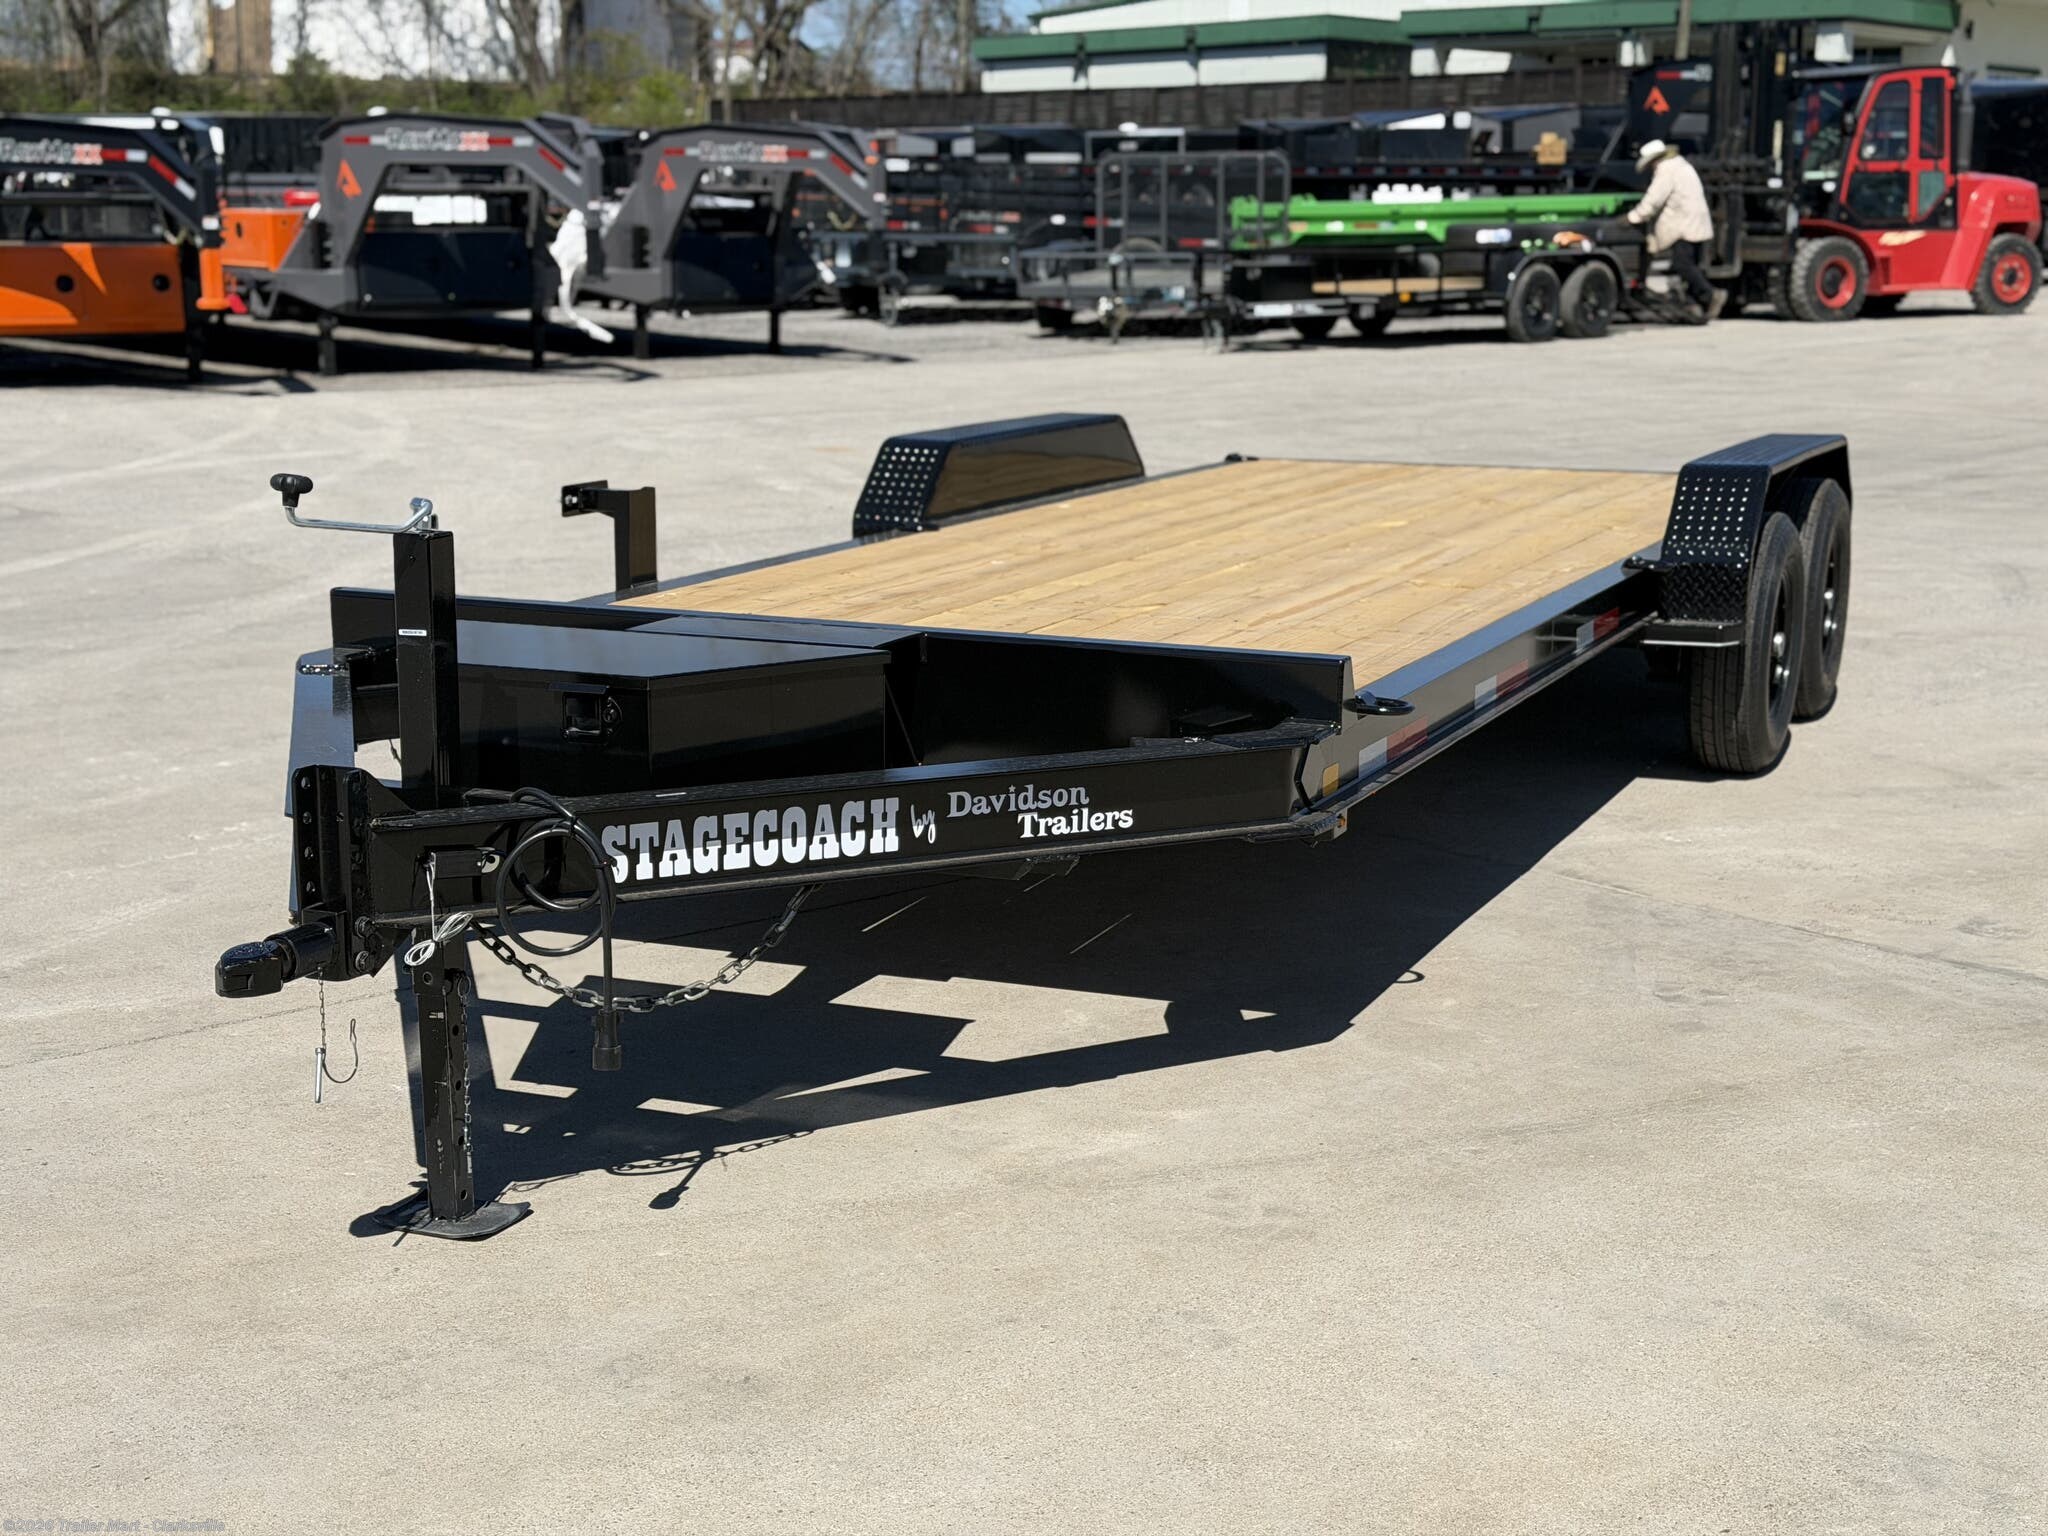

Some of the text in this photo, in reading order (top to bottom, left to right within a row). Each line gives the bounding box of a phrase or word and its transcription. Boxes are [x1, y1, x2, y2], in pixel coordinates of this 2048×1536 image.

[946, 784, 1090, 818] Davidson
[1018, 806, 1134, 839] Trailers
[601, 797, 936, 883] STAGECOACH by
